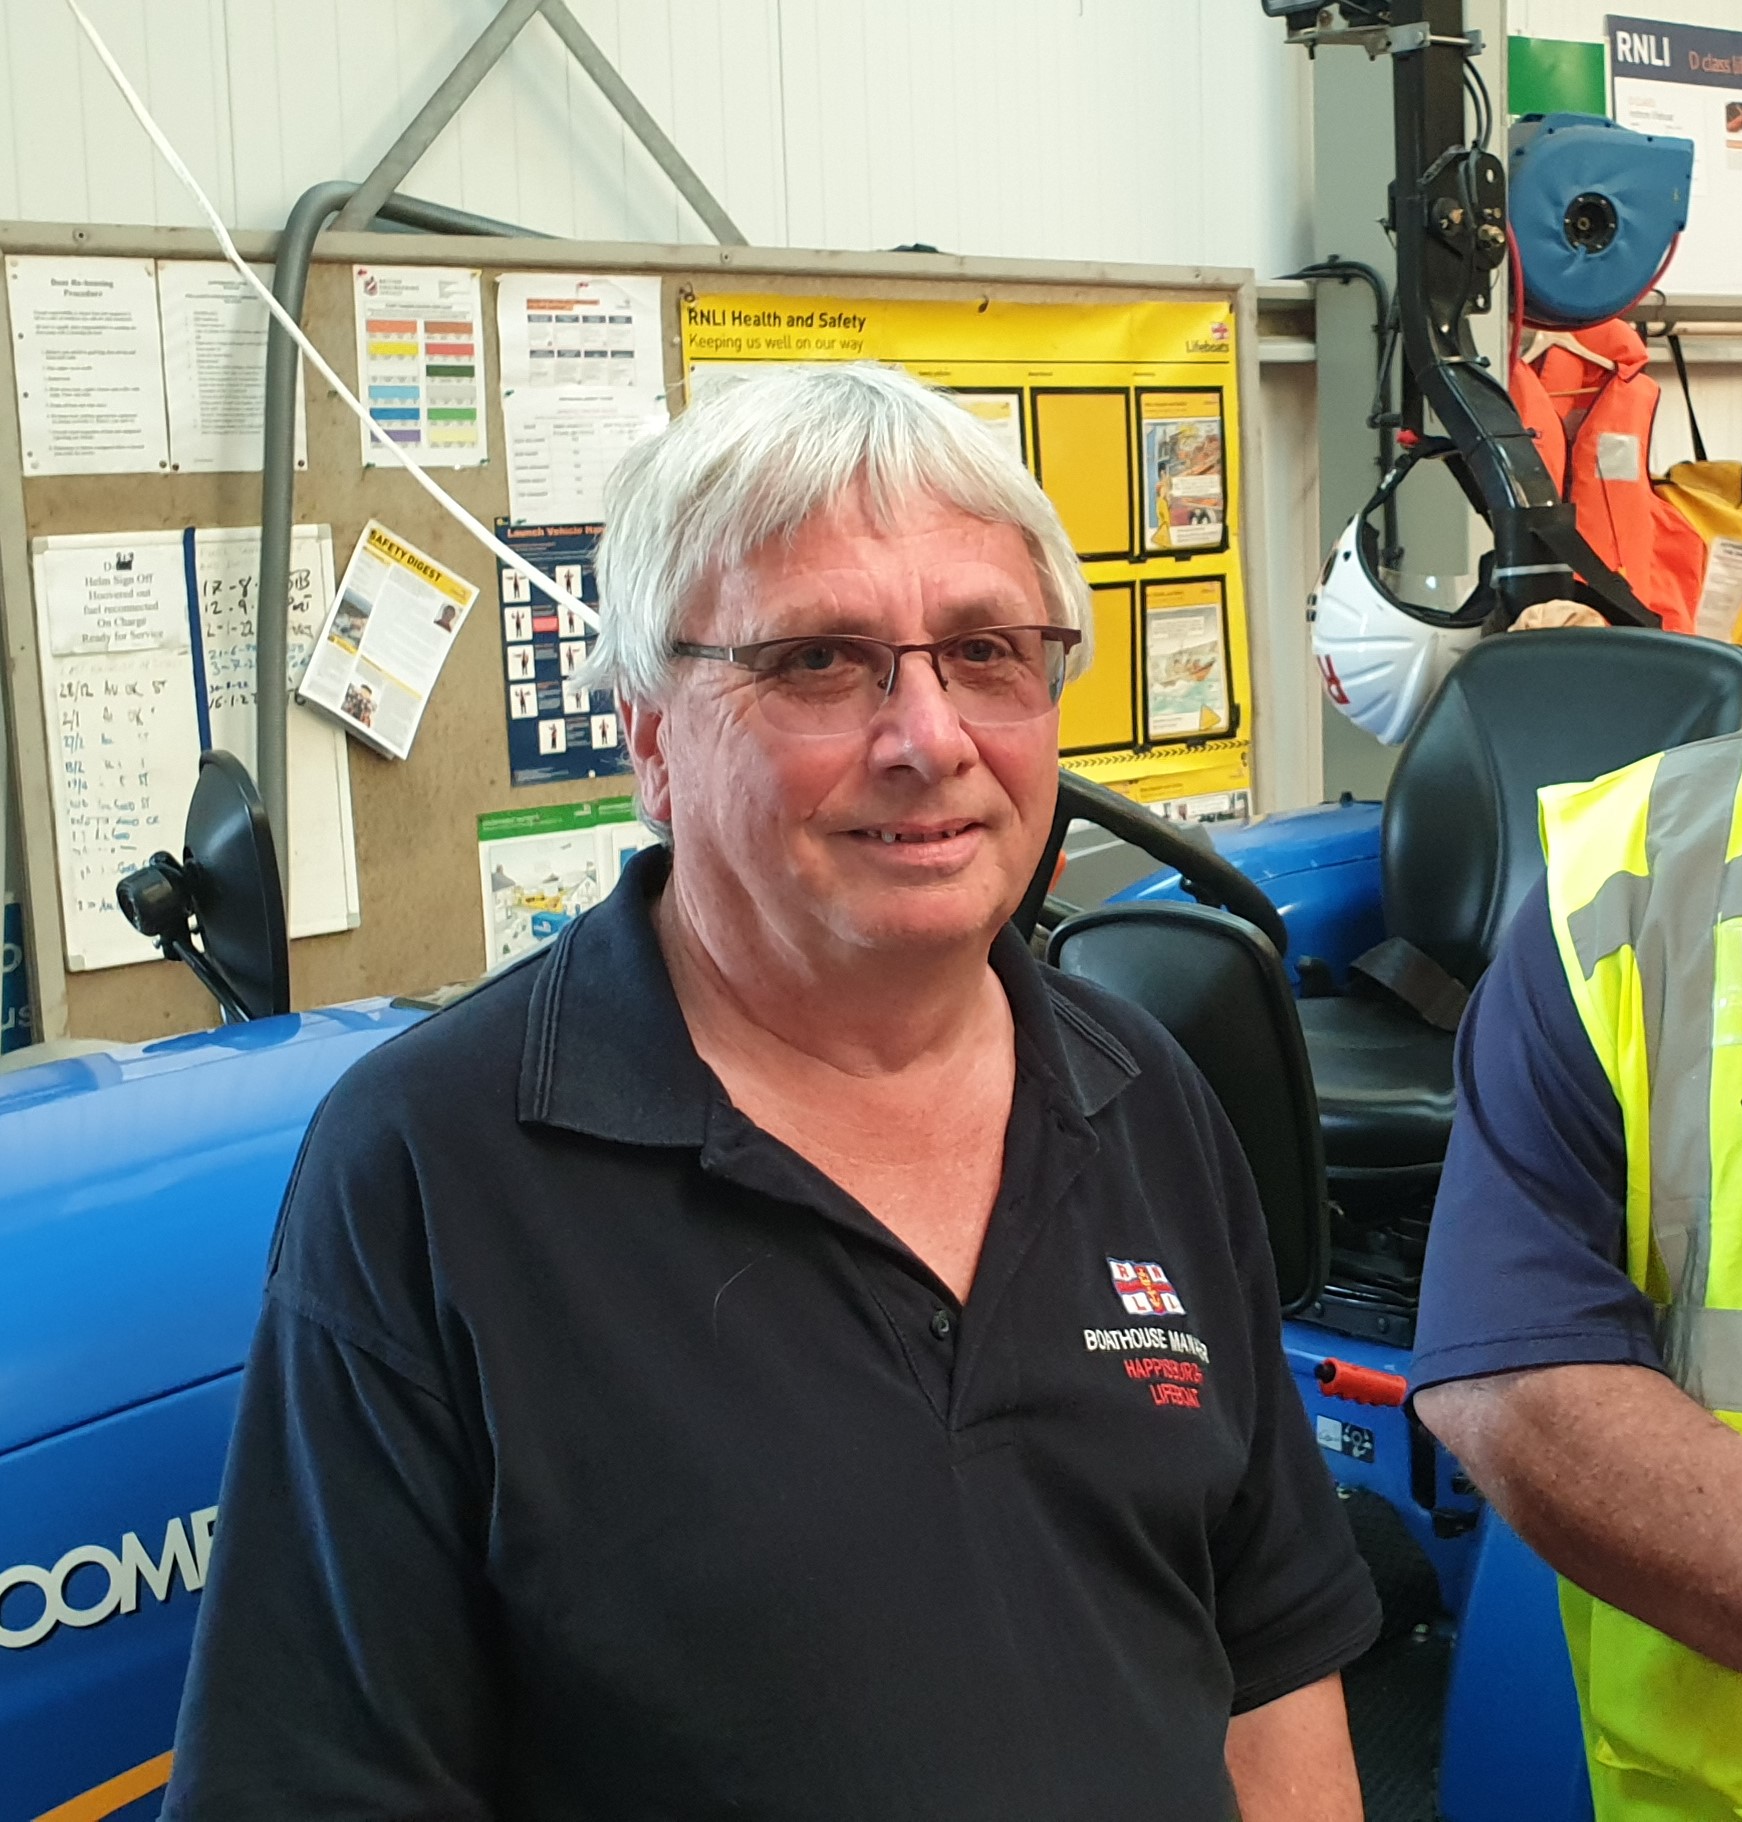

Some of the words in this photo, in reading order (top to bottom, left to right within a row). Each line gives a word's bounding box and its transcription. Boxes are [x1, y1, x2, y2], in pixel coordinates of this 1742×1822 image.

[1615, 30, 1670, 67] RNLI
[1688, 50, 1699, 70] D
[1702, 53, 1731, 74] class
[688, 308, 726, 327] RNLI
[731, 310, 781, 328] Health
[786, 312, 814, 328] and
[818, 312, 867, 333] Safety
[689, 333, 742, 353] Keeping
[746, 338, 762, 349] us
[765, 335, 792, 350] well
[795, 339, 812, 350] on
[815, 338, 836, 350] our
[839, 339, 864, 353] way
[370, 529, 407, 561] SAFETY
[407, 554, 443, 582] DIGEST
[114, 575, 134, 587] Sign
[137, 573, 153, 584] Off
[97, 618, 111, 628] On
[82, 632, 111, 644] Ready
[114, 631, 127, 641] for
[1083, 1327, 1168, 1351] BOATHOUSE
